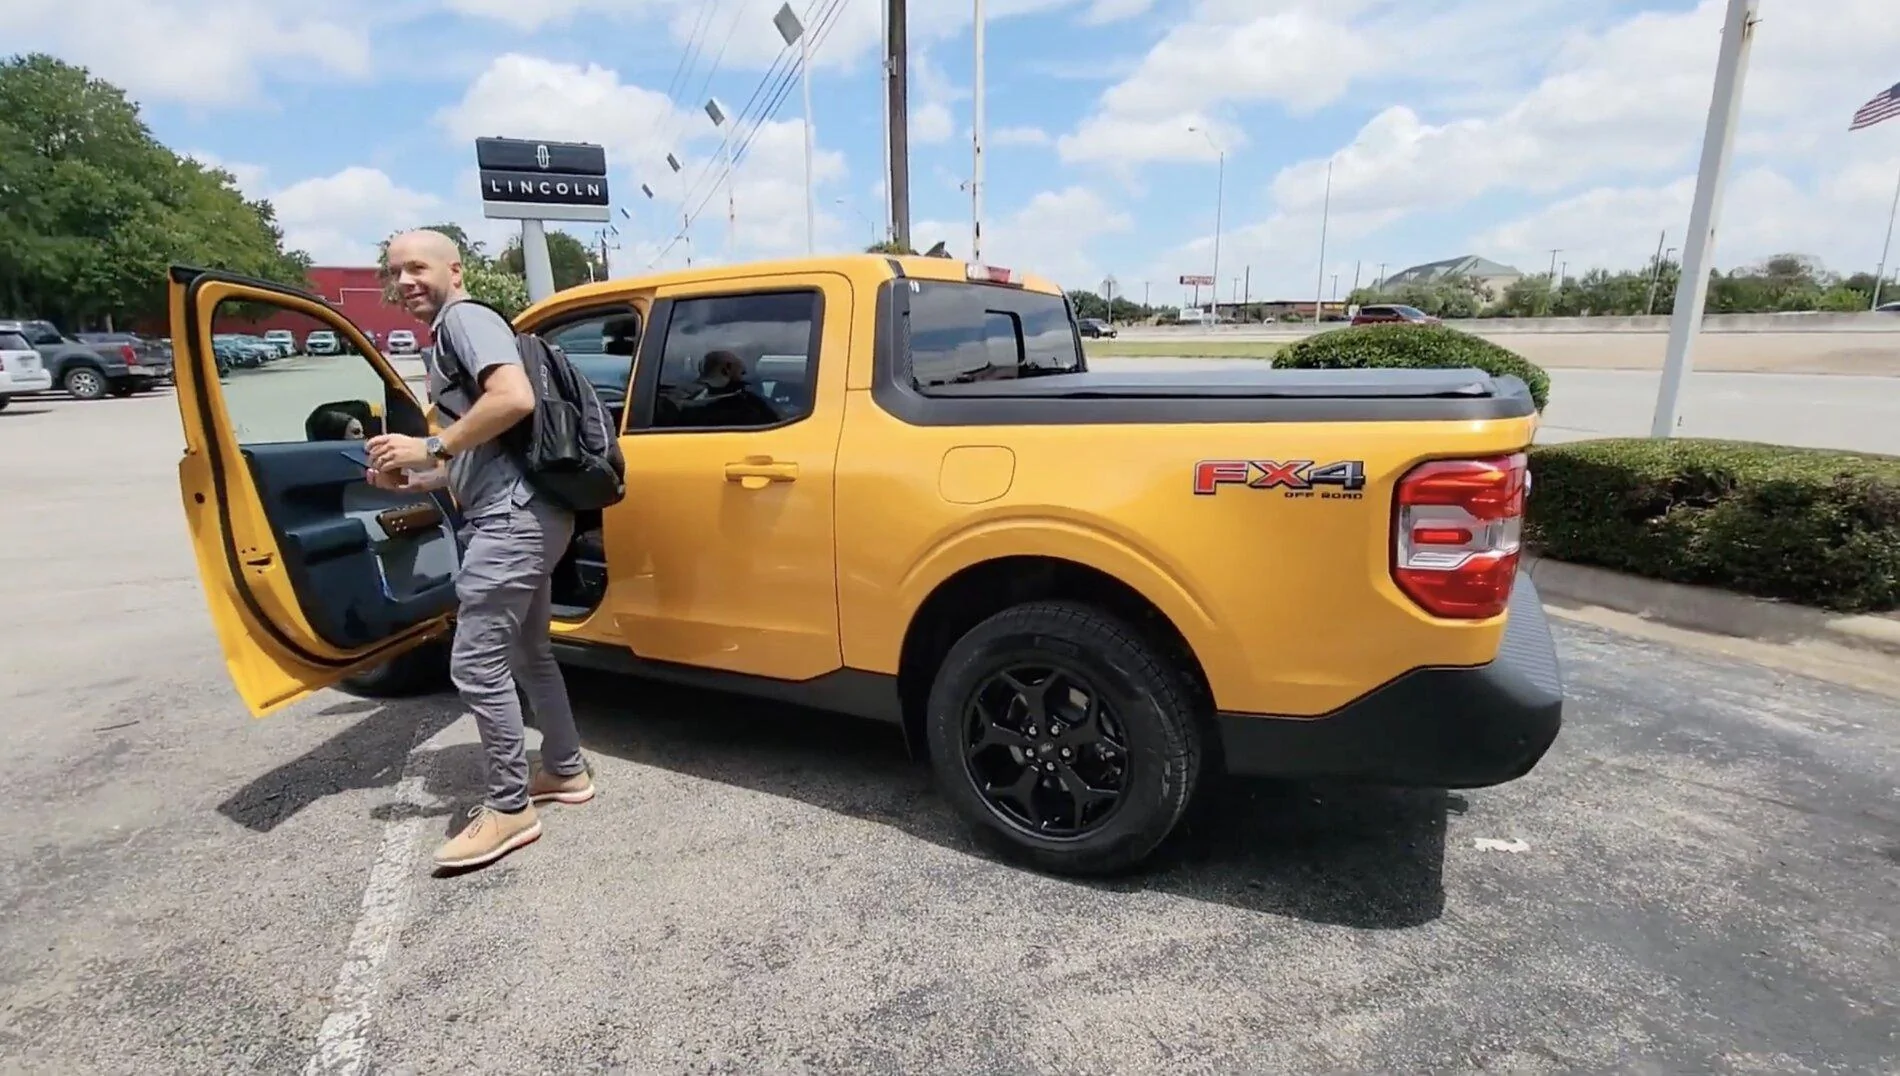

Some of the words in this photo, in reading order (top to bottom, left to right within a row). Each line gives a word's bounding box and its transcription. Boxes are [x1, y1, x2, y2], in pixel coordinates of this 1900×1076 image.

[491, 178, 600, 197] LINCOLN
[1194, 460, 1366, 495] FX4
[1284, 491, 1315, 499] OFF
[1321, 491, 1363, 500] ROAD
